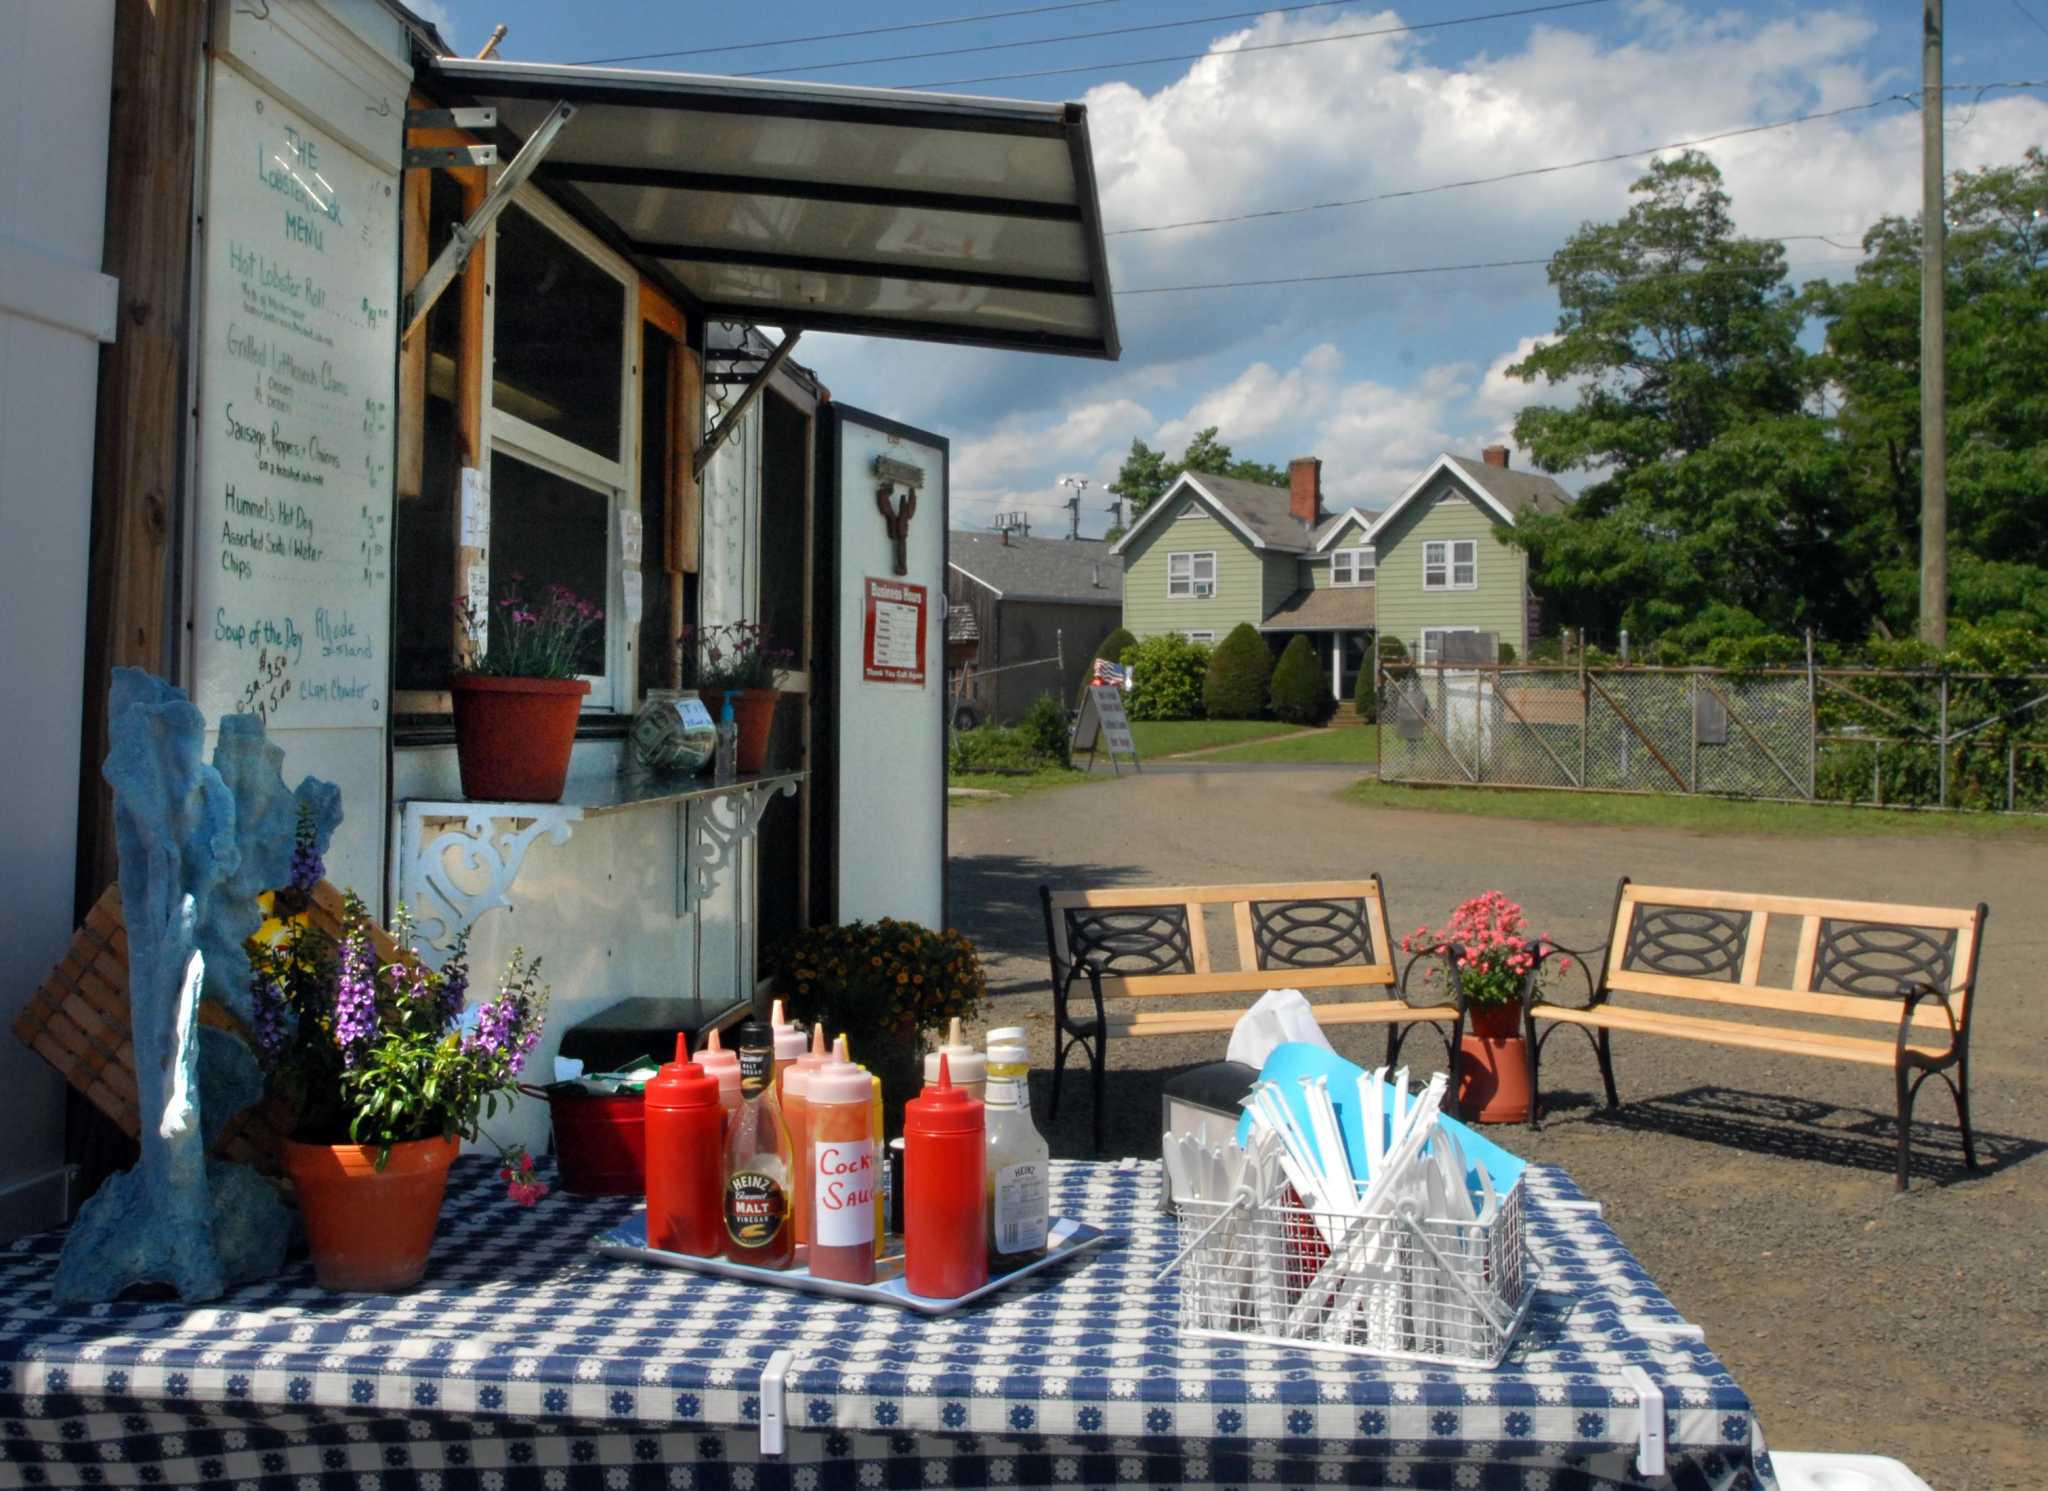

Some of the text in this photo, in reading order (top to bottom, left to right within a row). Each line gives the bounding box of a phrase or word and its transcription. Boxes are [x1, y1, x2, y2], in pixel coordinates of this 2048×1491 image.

[284, 124, 319, 171] THE
[286, 209, 324, 254] MENU
[229, 239, 256, 279] Hot
[260, 255, 302, 298] Lobster
[305, 276, 327, 310] Roll
[227, 322, 267, 368] Grilled
[278, 498, 294, 526] Hot
[295, 504, 314, 541] Dog
[222, 549, 252, 580] Chips
[294, 538, 323, 561] Water
[872, 581, 922, 604] Business Hours
[214, 604, 304, 666] Soup of the Day
[315, 606, 357, 645] Rhode
[322, 634, 372, 660] Island
[330, 671, 371, 703] Chowder
[866, 667, 884, 677] Thank
[908, 671, 924, 681] Again
[732, 1175, 770, 1191] HEINZ
[1014, 1165, 1036, 1177] HEINZ
[735, 1201, 769, 1214] MALT
[736, 1215, 769, 1223] VINEGAR
